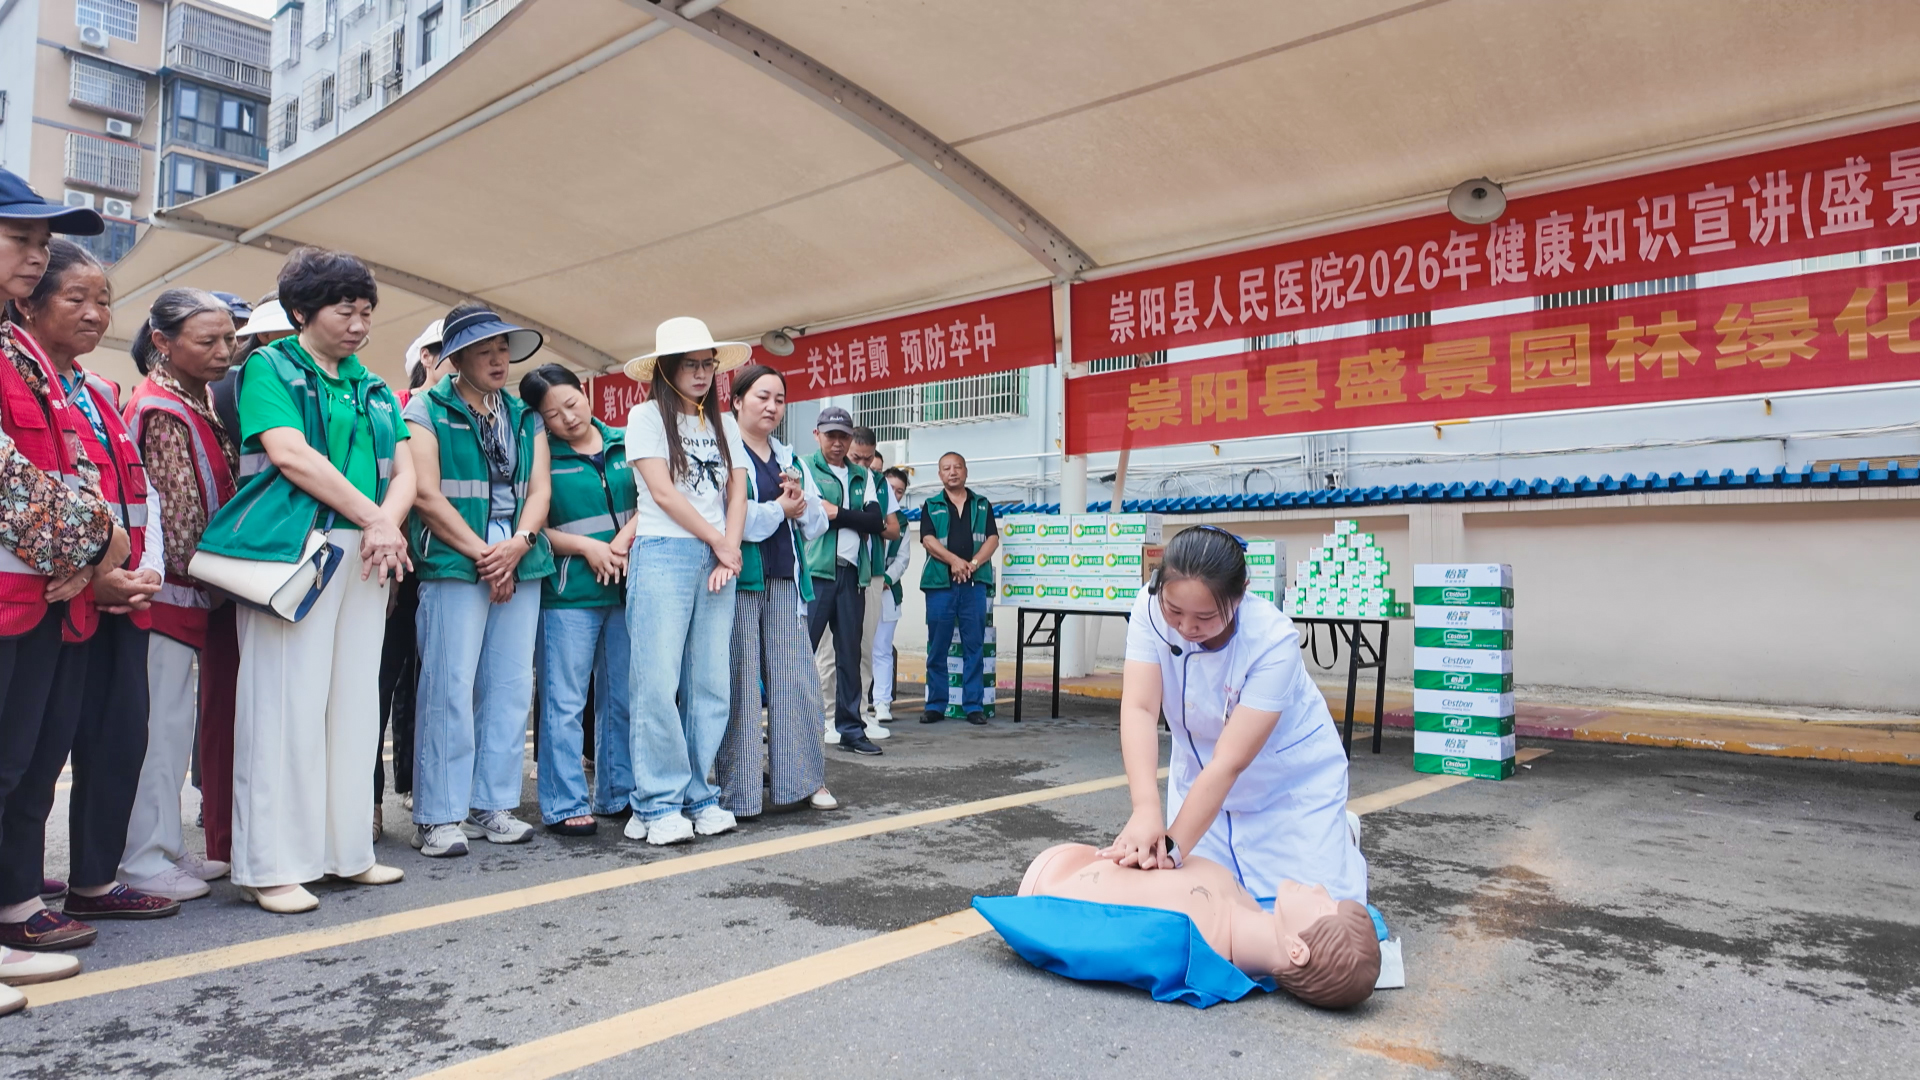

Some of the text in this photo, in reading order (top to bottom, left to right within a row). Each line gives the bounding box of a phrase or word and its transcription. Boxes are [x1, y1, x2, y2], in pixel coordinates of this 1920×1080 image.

[900, 313, 997, 375] 预防卒中
[1126, 281, 1920, 432] 崇阳县盛景园林绿化
[702, 438, 721, 448] PA
